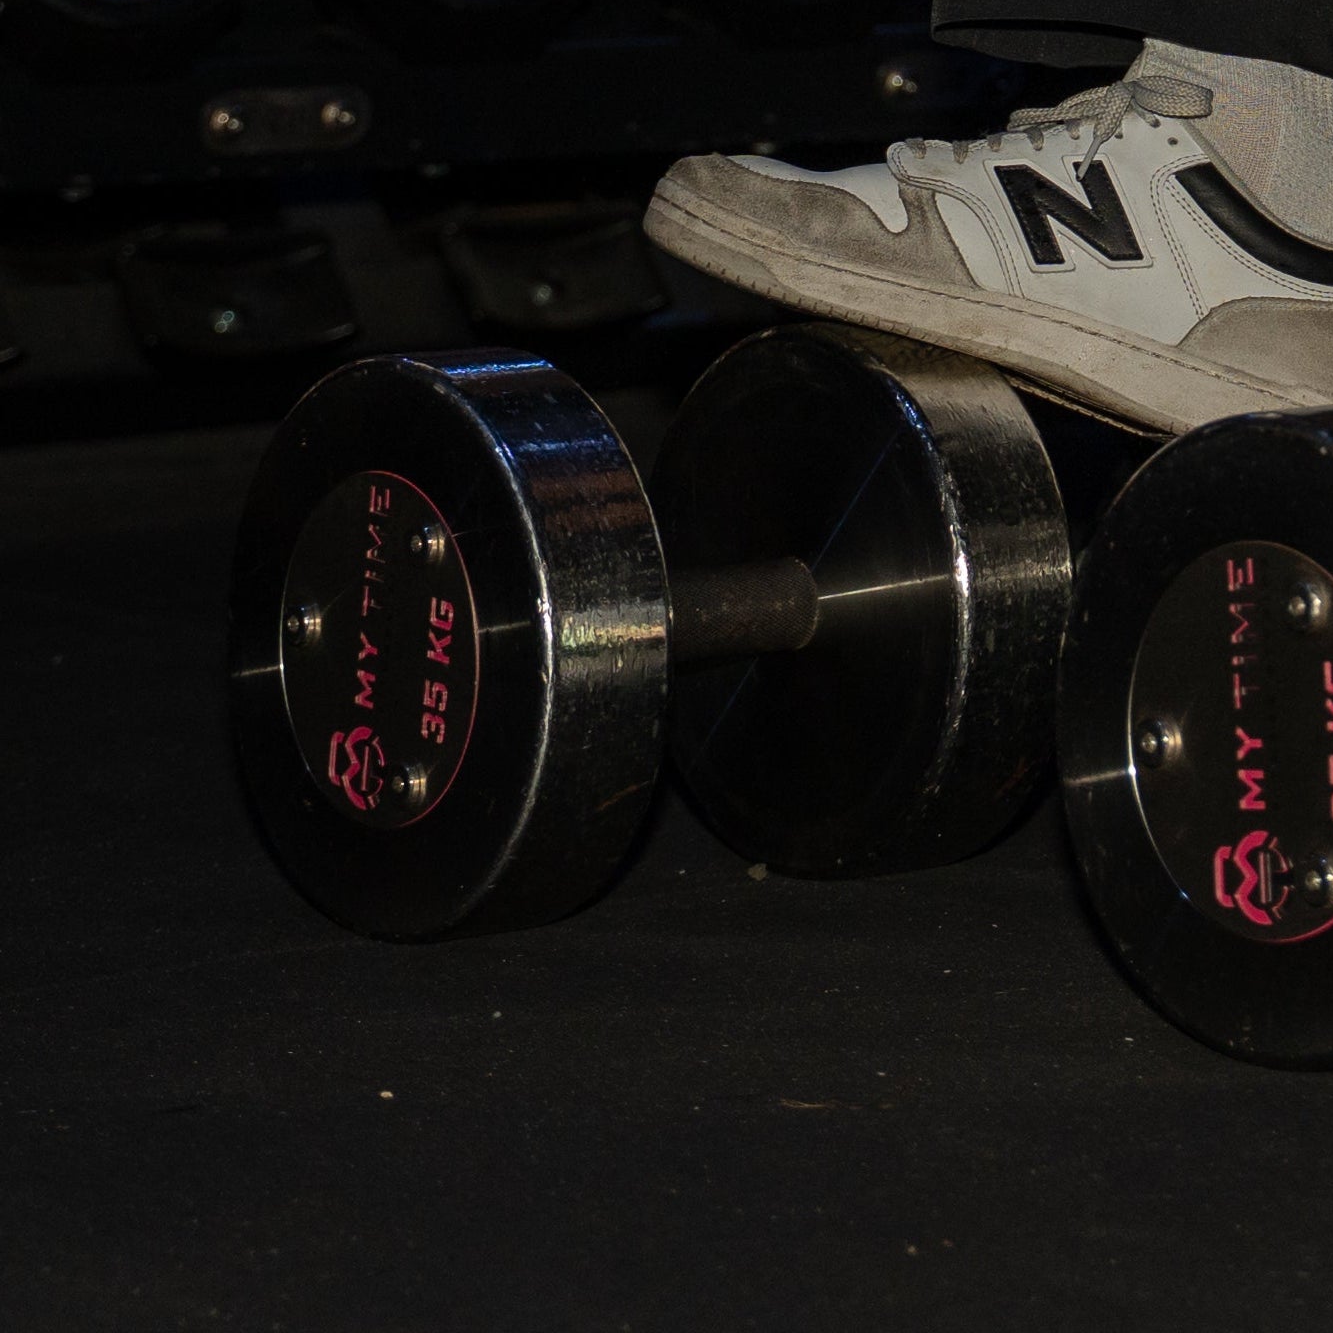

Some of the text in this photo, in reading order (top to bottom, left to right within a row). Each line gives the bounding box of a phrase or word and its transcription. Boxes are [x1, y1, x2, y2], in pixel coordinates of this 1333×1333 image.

[994, 160, 1145, 265] N
[354, 484, 391, 710] MY TIME
[420, 596, 455, 745] 35 KG
[1226, 557, 1267, 811] MY TIME
